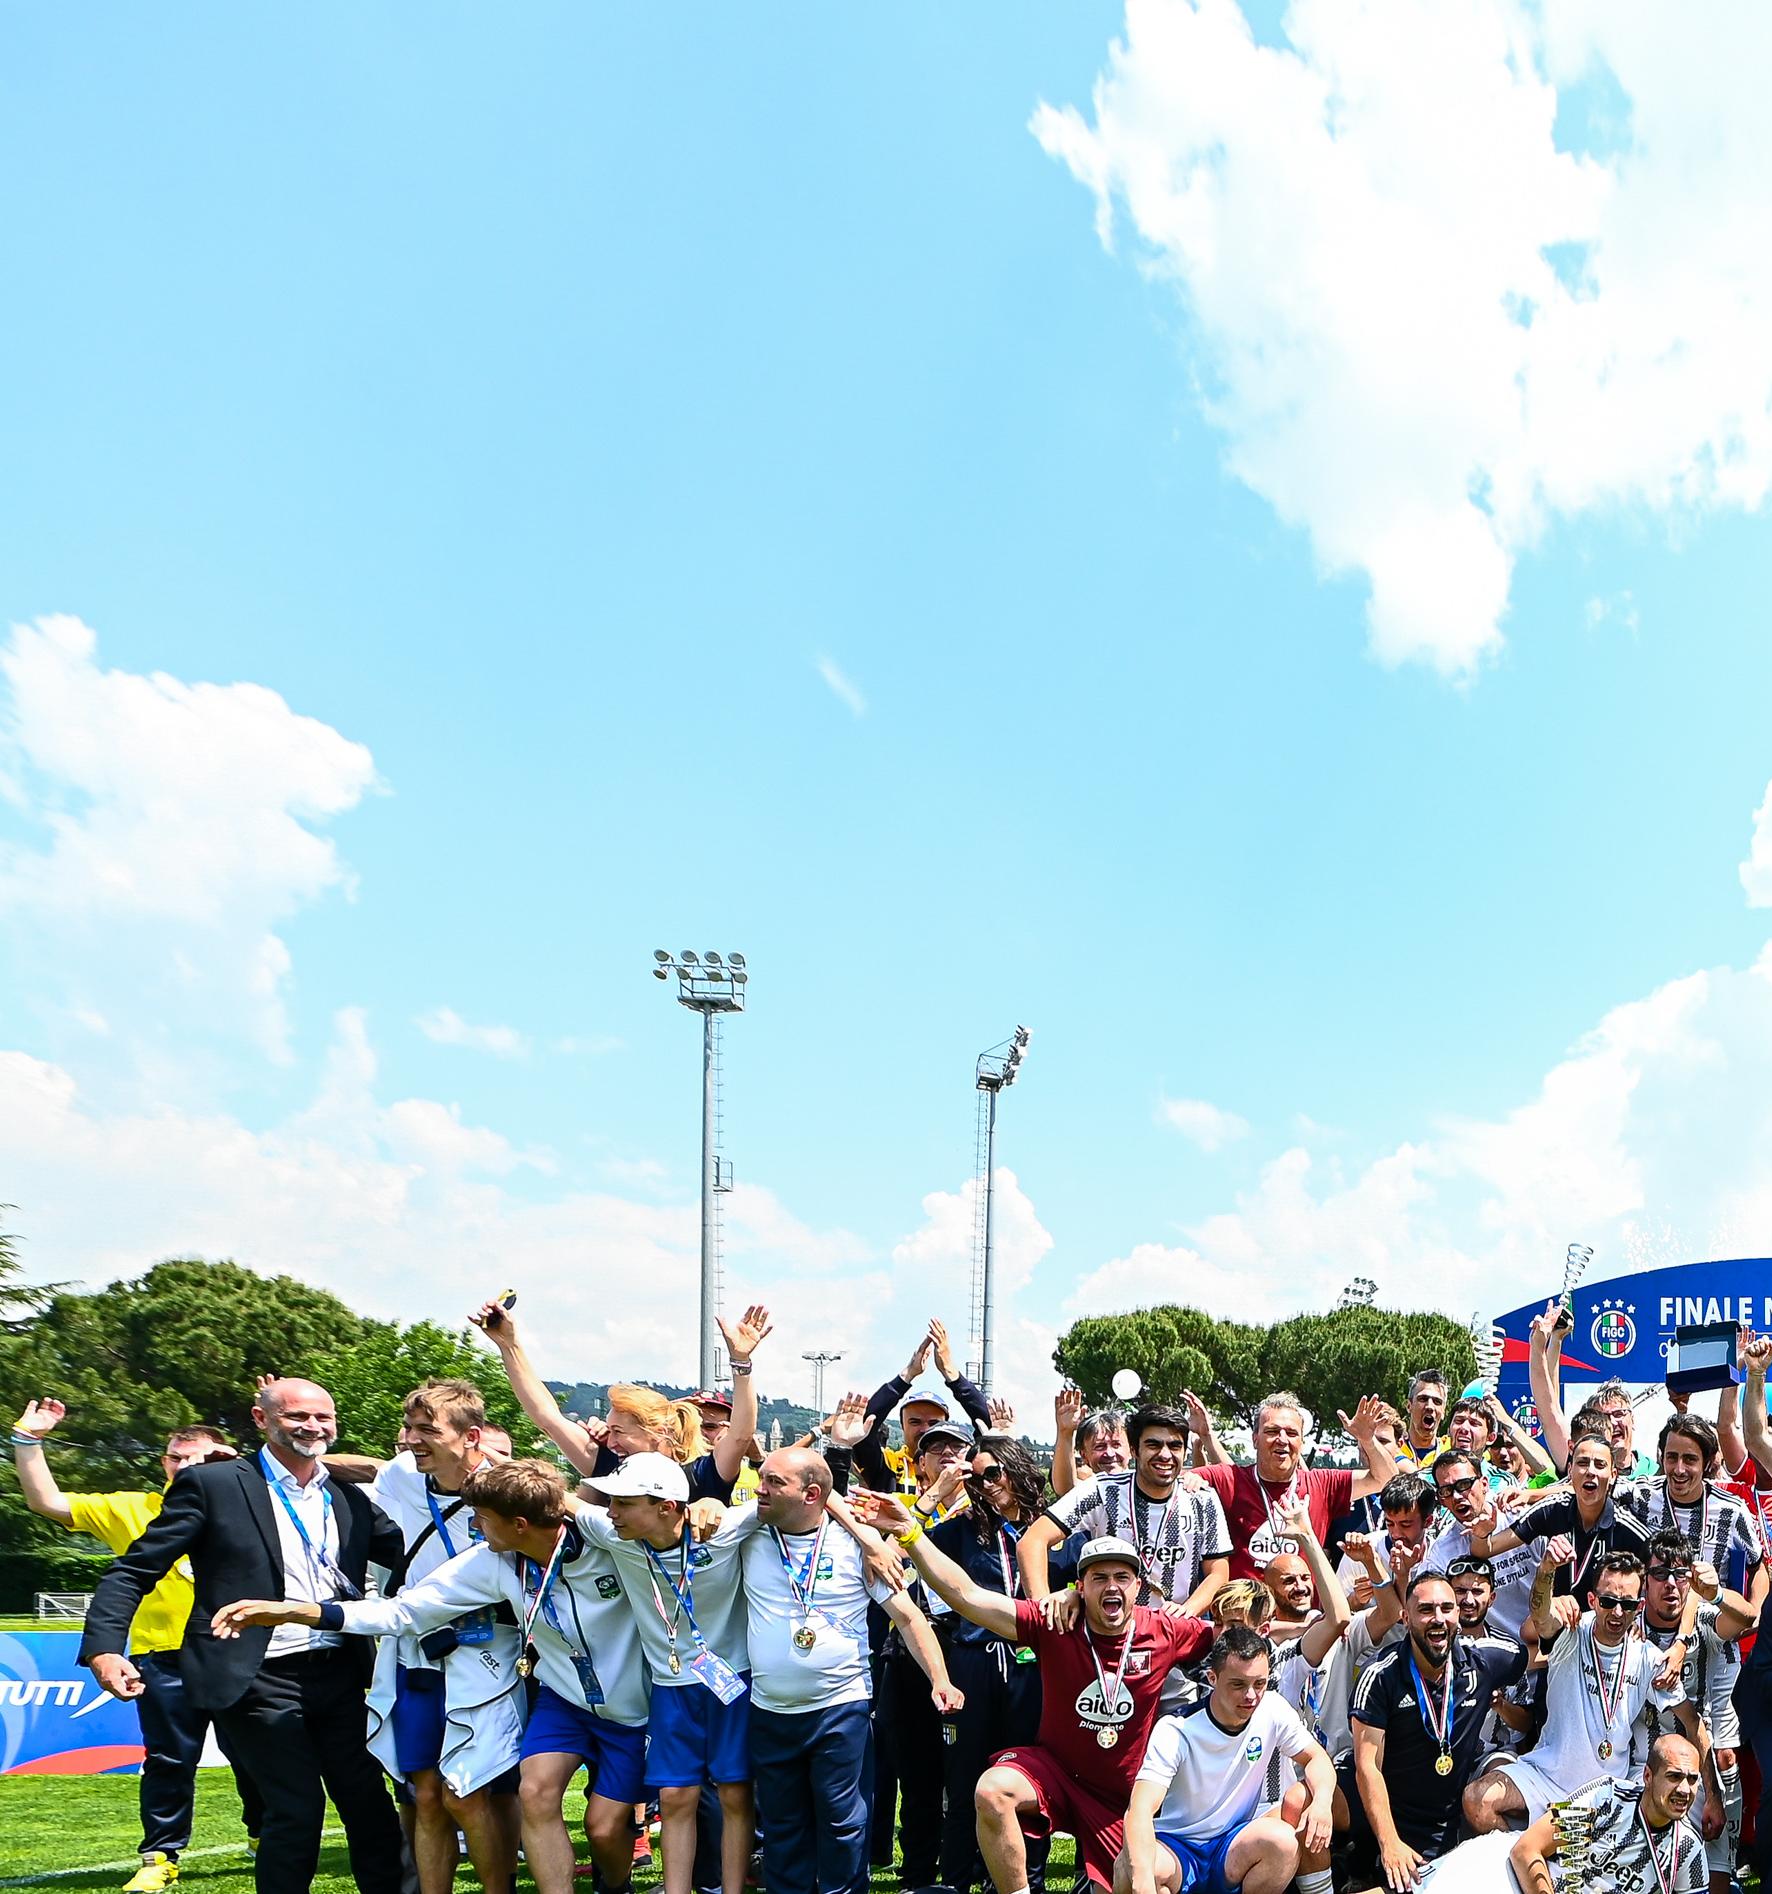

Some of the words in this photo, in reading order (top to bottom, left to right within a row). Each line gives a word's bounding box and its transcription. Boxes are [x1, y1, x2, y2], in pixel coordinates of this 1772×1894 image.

[1660, 1297, 1753, 1325] FINALE
[1602, 1326, 1625, 1338] FIGC
[1520, 1416, 1537, 1425] FIGC
[1140, 1545, 1187, 1567] eep
[1496, 1559, 1510, 1571] FOR
[1589, 1849, 1645, 1893] Jeep
